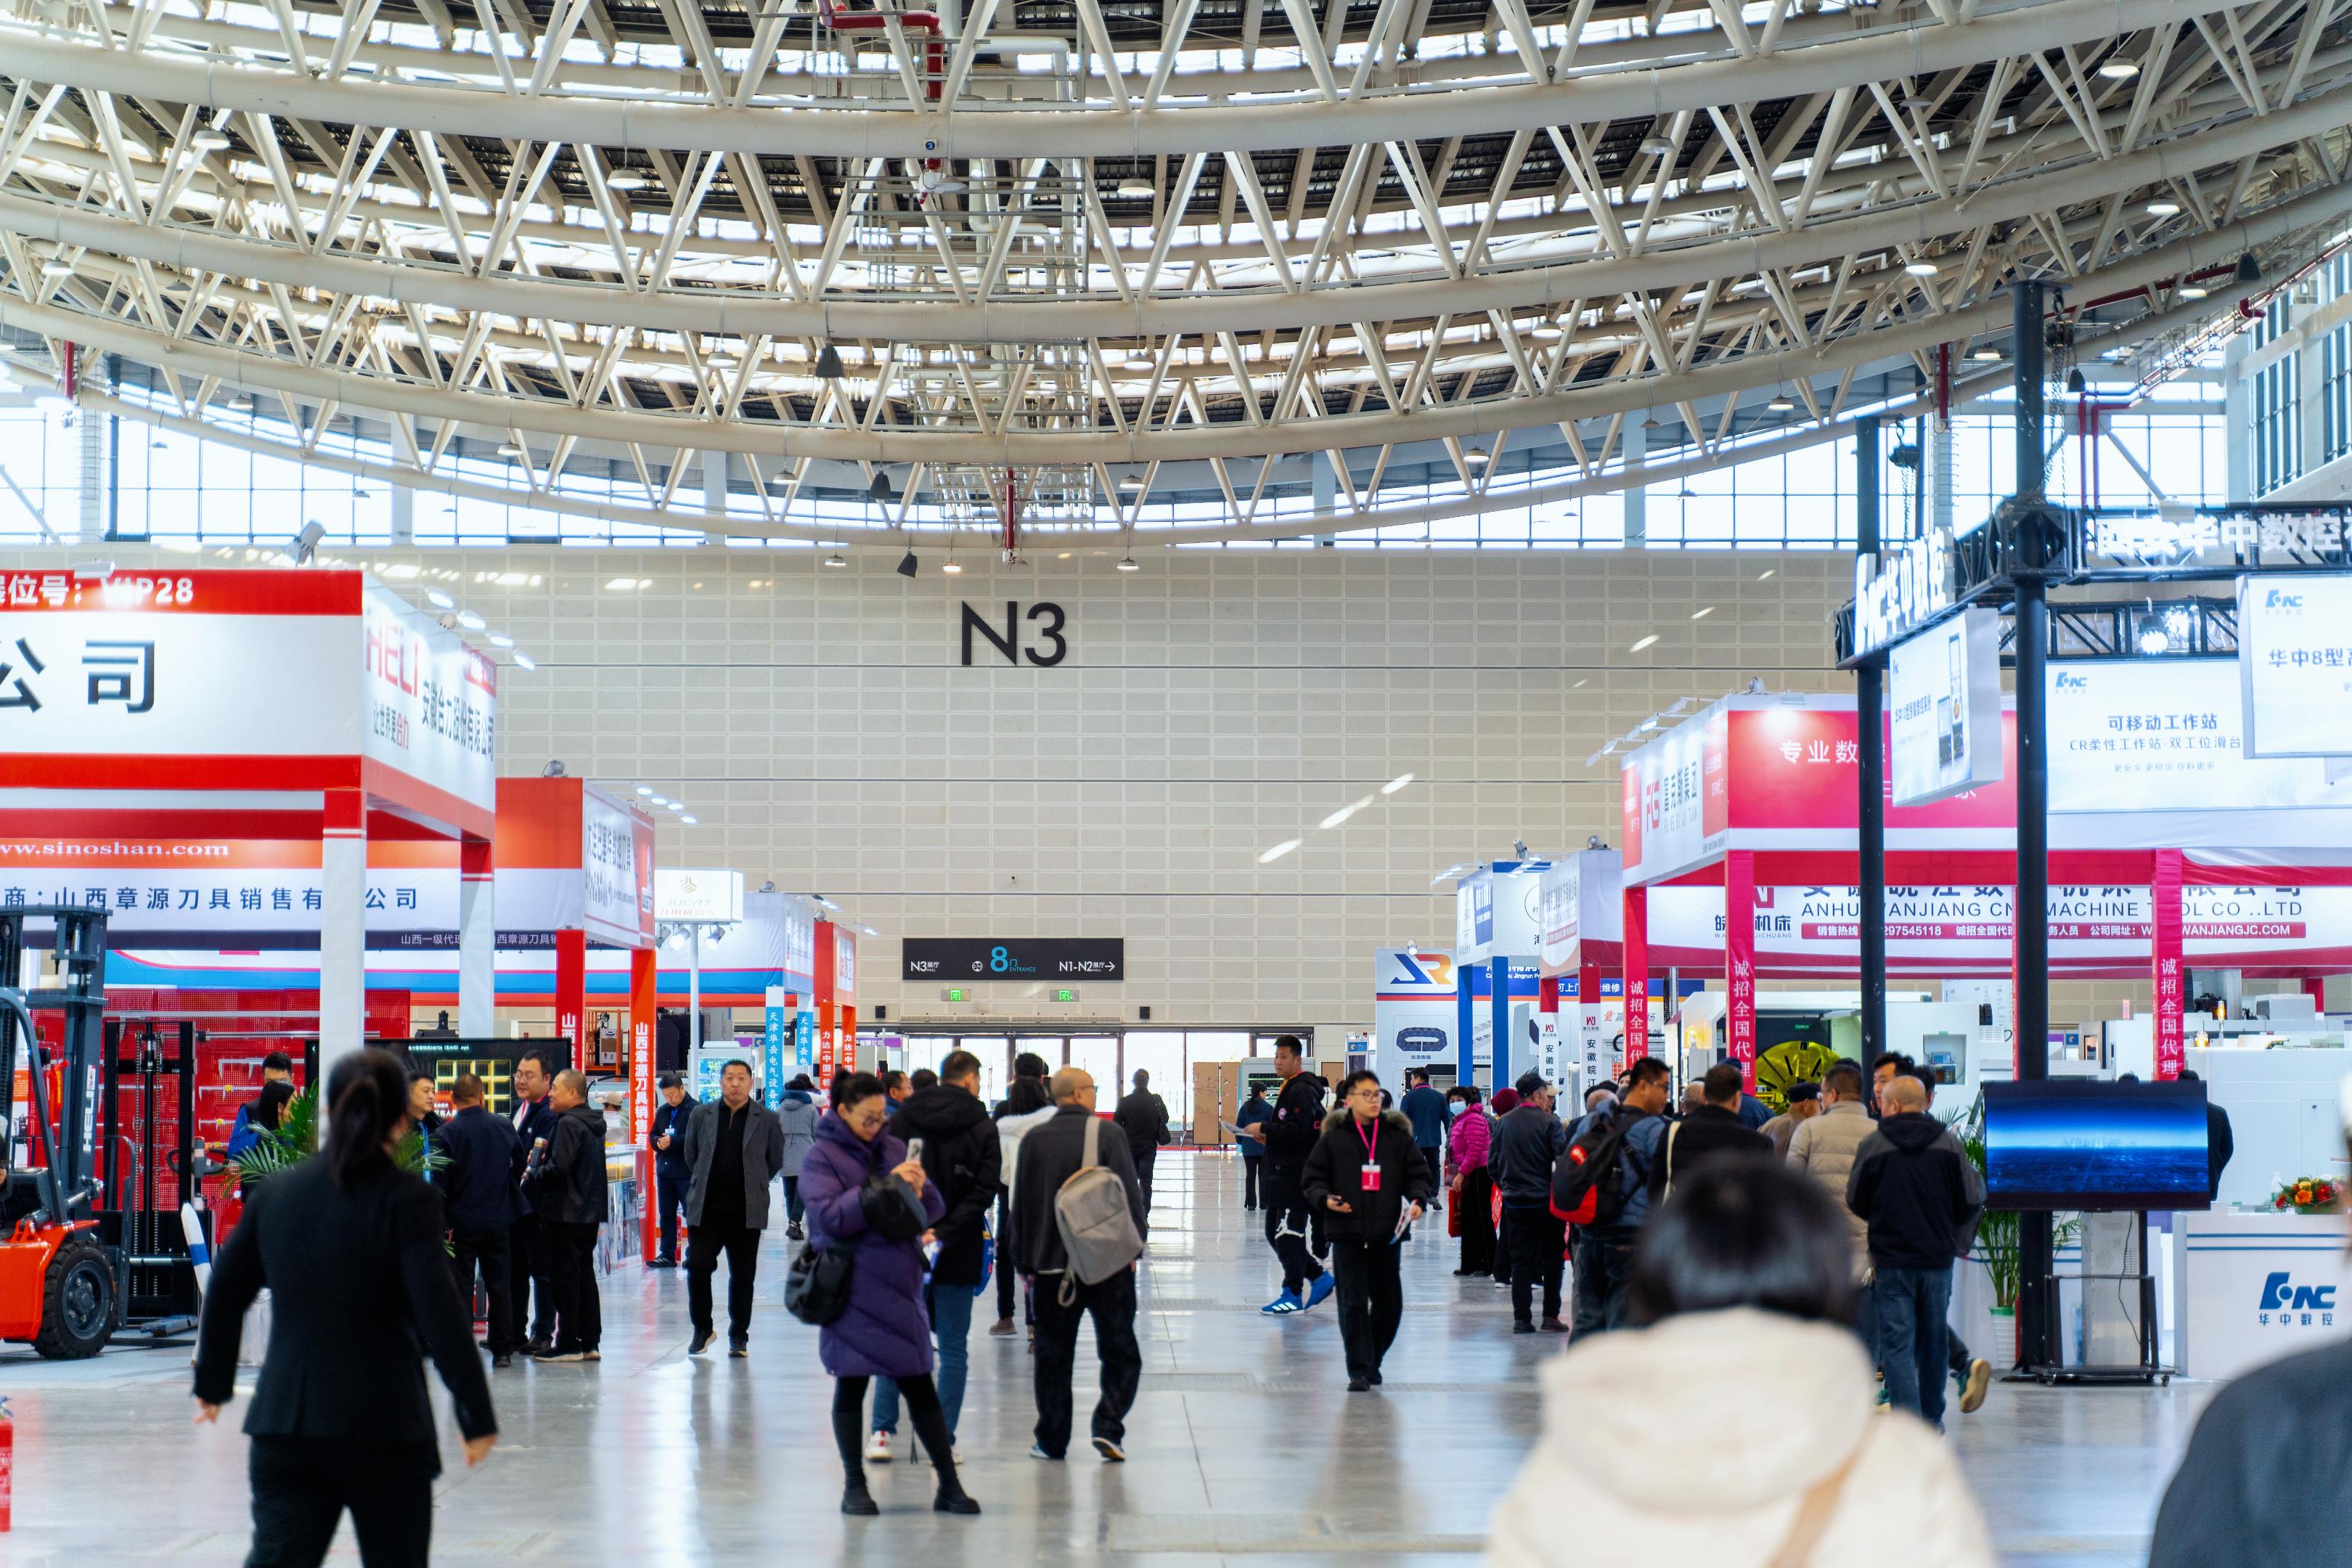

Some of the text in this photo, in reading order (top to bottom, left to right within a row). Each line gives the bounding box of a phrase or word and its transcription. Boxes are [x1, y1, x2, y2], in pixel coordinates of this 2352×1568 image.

[2096, 513, 2352, 560] 西安华中数控
[960, 600, 1066, 666] N3
[2107, 713, 2218, 732] 可移动工作站
[1802, 902, 1860, 917] ANHU
[1884, 902, 1981, 917] ANJIANG
[2047, 902, 2139, 916] MACHINE
[910, 960, 927, 972] N3
[990, 946, 1008, 972] 8
[1059, 960, 1093, 972] N1-N2
[2160, 957, 2178, 1074] 诚招全国代理
[2258, 1312, 2333, 1326] 华中数控
